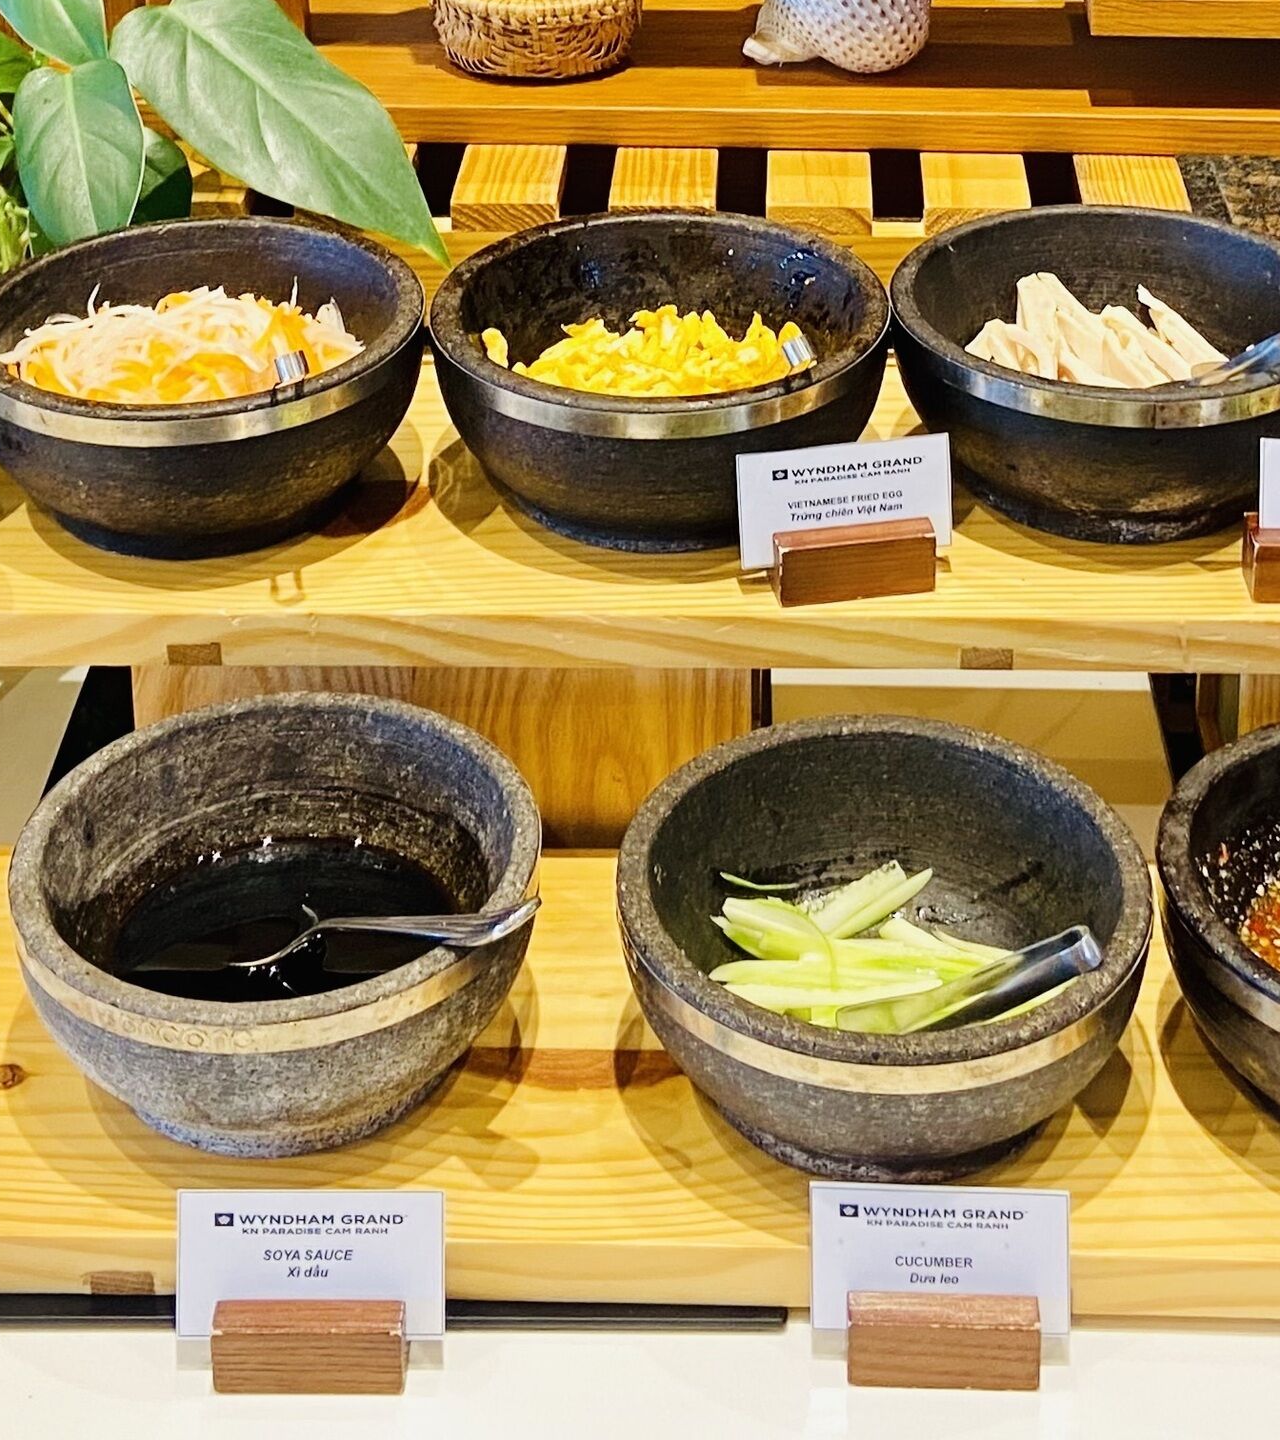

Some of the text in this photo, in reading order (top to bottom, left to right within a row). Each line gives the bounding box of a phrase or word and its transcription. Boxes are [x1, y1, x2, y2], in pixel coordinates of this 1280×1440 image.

[791, 456, 923, 478] WYNDHAM GRAND
[860, 470, 881, 479] CAM
[787, 490, 903, 510] VIETNAMESE FRIED EGG
[879, 502, 903, 513] Nam
[238, 1214, 405, 1225] WYNDHAM GRAND
[863, 1206, 1025, 1221] WYNDHAM GRAND
[886, 1220, 944, 1229] PARADISE
[947, 1221, 972, 1230] CAM
[976, 1222, 1009, 1230] RANH
[262, 1249, 354, 1261] SOYA SAUCE
[894, 1255, 974, 1269] CUCUMBER
[939, 1273, 960, 1285] leo
